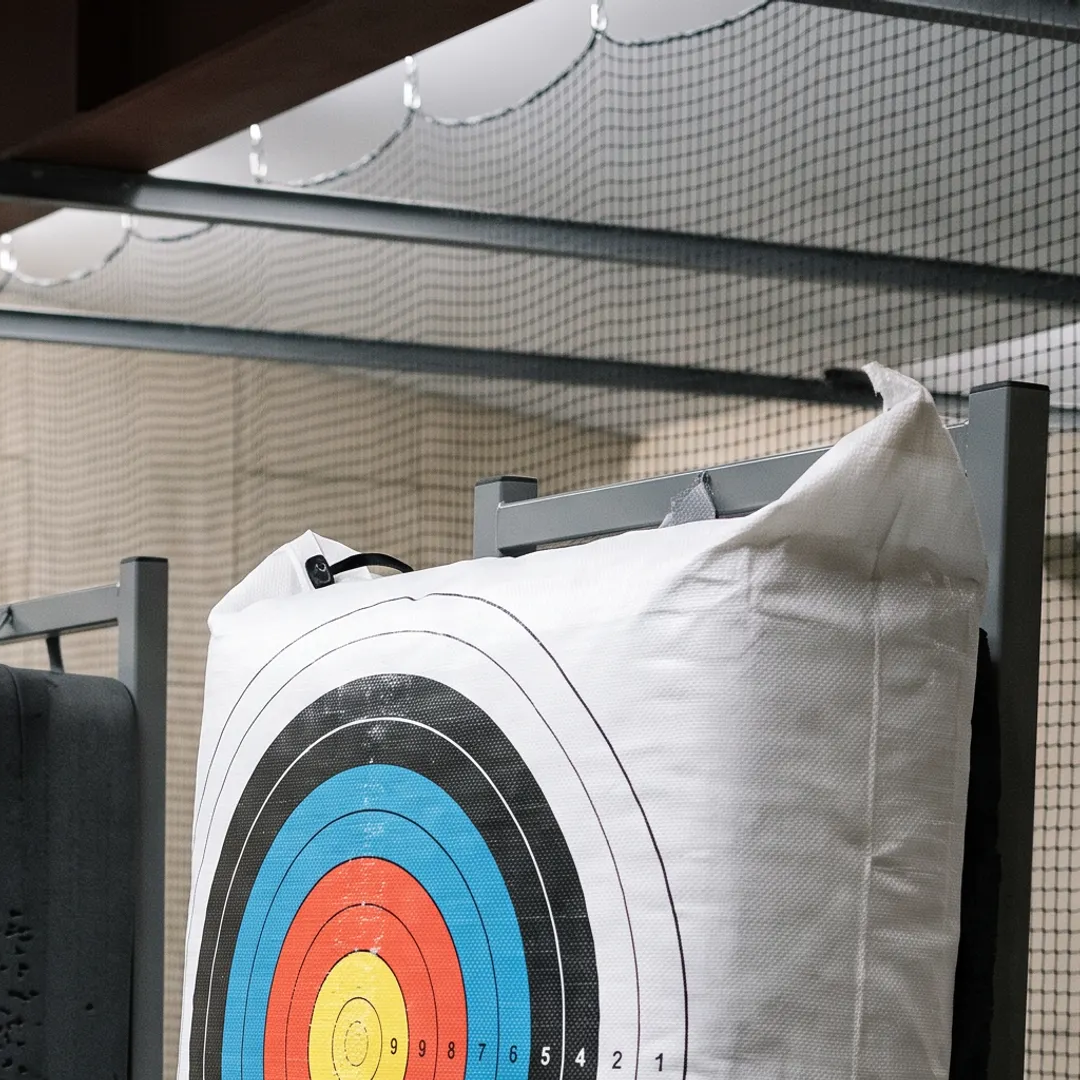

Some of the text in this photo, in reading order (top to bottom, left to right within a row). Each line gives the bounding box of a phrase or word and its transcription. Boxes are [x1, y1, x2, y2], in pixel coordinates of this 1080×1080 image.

[390, 1037, 664, 1072] 9 9 8 7 6 5 4 2 1
